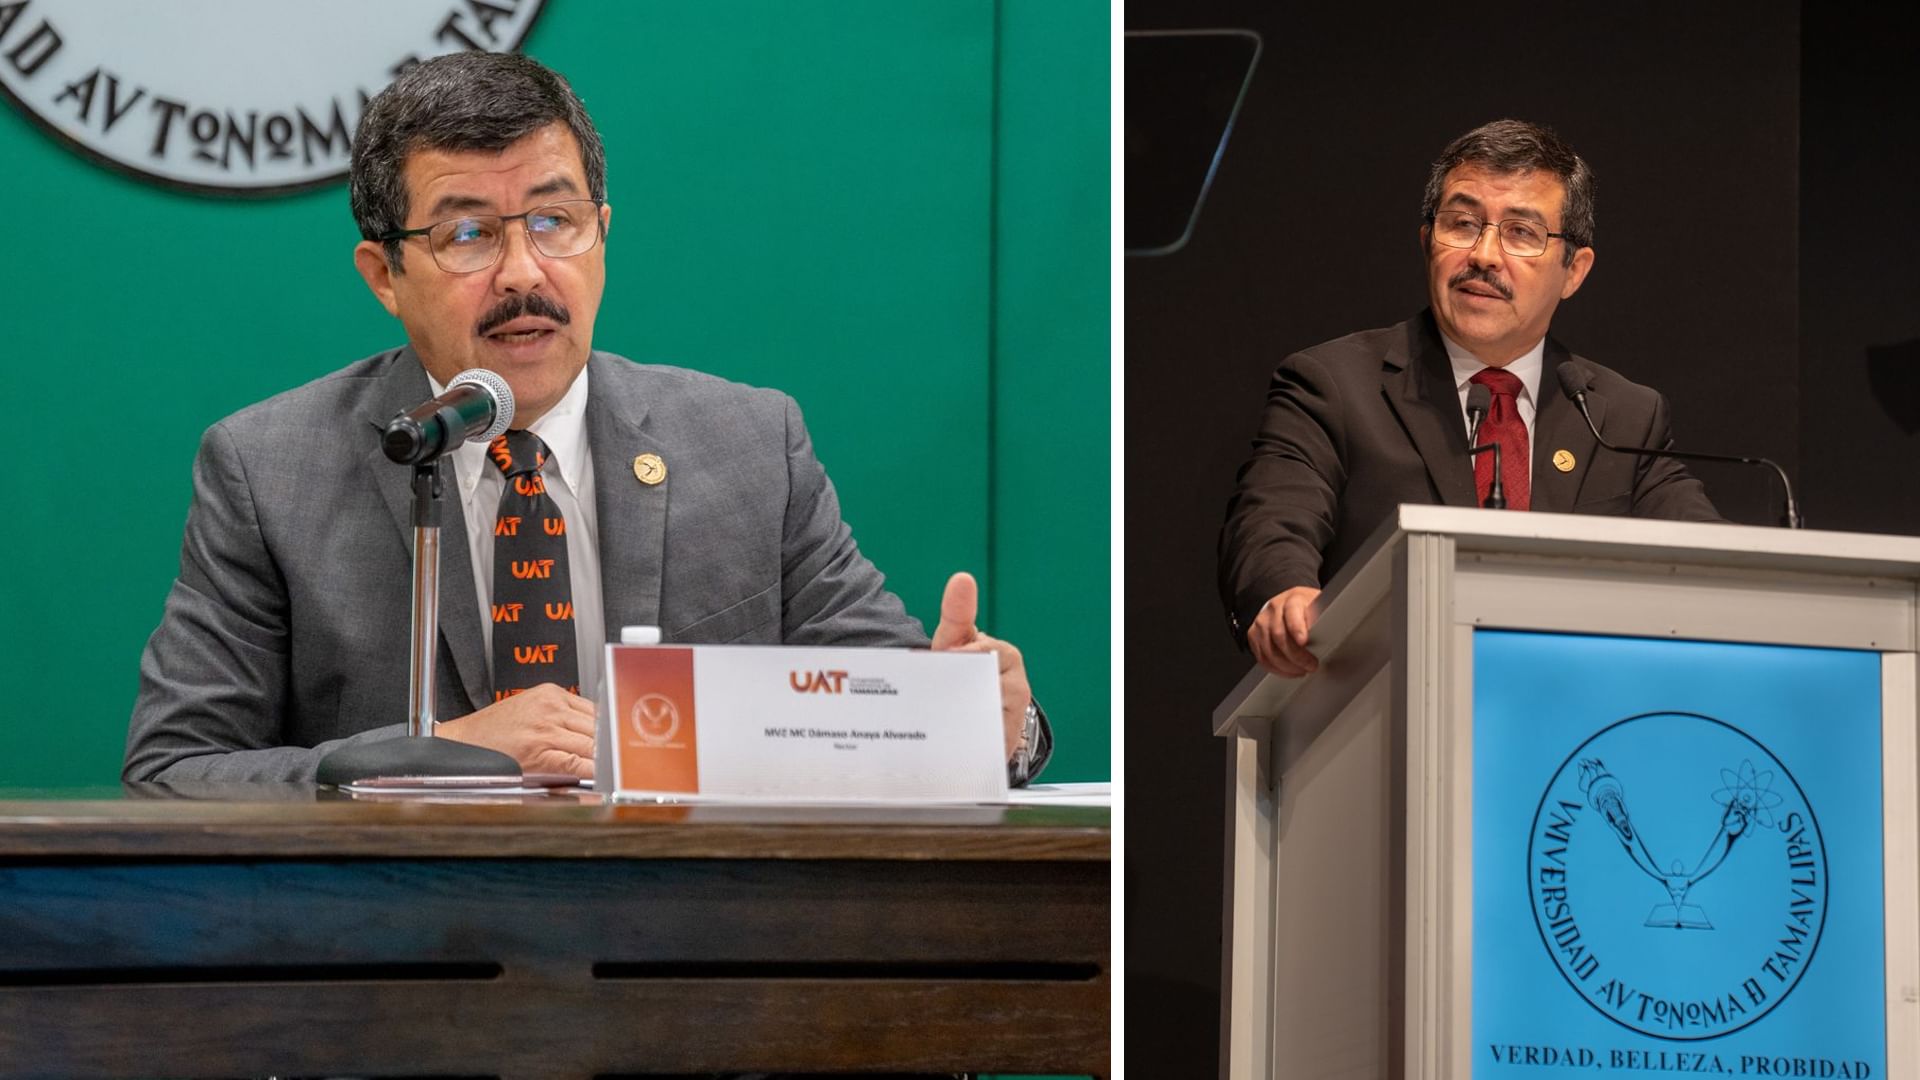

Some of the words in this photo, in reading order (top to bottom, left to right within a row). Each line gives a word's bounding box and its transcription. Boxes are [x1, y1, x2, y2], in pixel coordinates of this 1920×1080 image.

[54, 67, 368, 171] AVTONOM
[511, 559, 555, 579] UAT
[514, 644, 559, 665] UAT
[790, 670, 848, 694] UAT
[1489, 1044, 1603, 1070] VERDAD,
[1610, 1049, 1733, 1076] BELLEZA,
[1740, 1055, 1871, 1080] PROBIDAD
